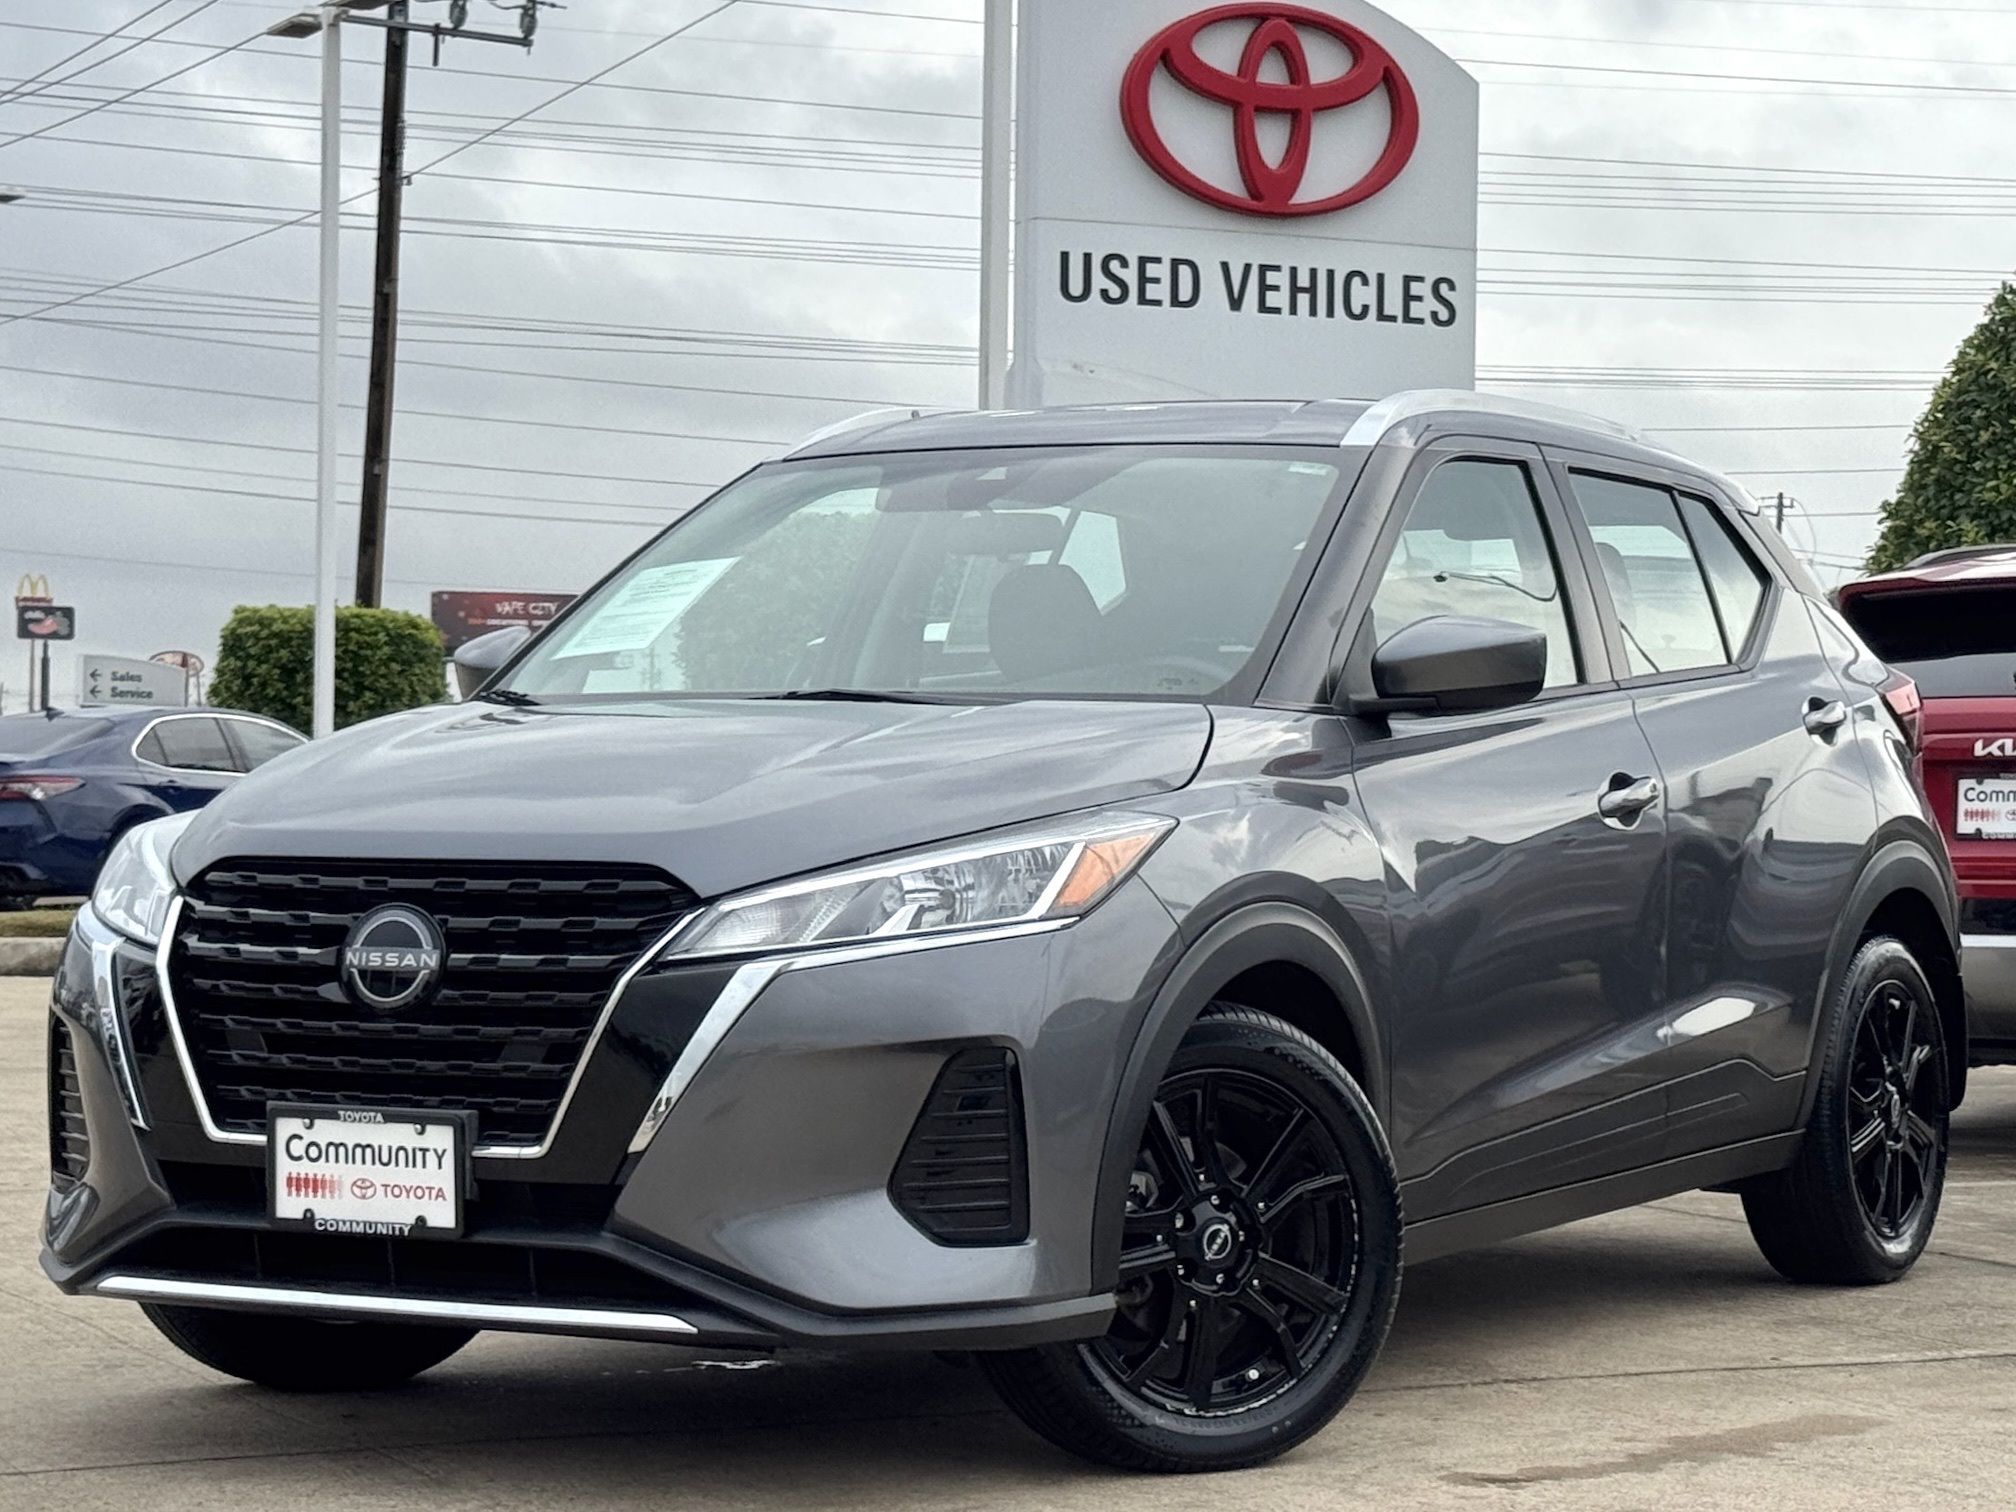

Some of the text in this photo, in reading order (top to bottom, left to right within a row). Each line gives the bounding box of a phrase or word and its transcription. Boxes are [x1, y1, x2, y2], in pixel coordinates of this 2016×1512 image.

[1059, 250, 1457, 328] USED VEHICLES
[495, 601, 527, 615] VAPE
[110, 671, 142, 682] Sales
[110, 686, 153, 699] Service
[345, 951, 438, 967] NISSAN
[338, 1110, 385, 1123] TOYOTA
[381, 1183, 448, 1201] TOYOTA
[314, 1218, 414, 1237] COMMUNITY
